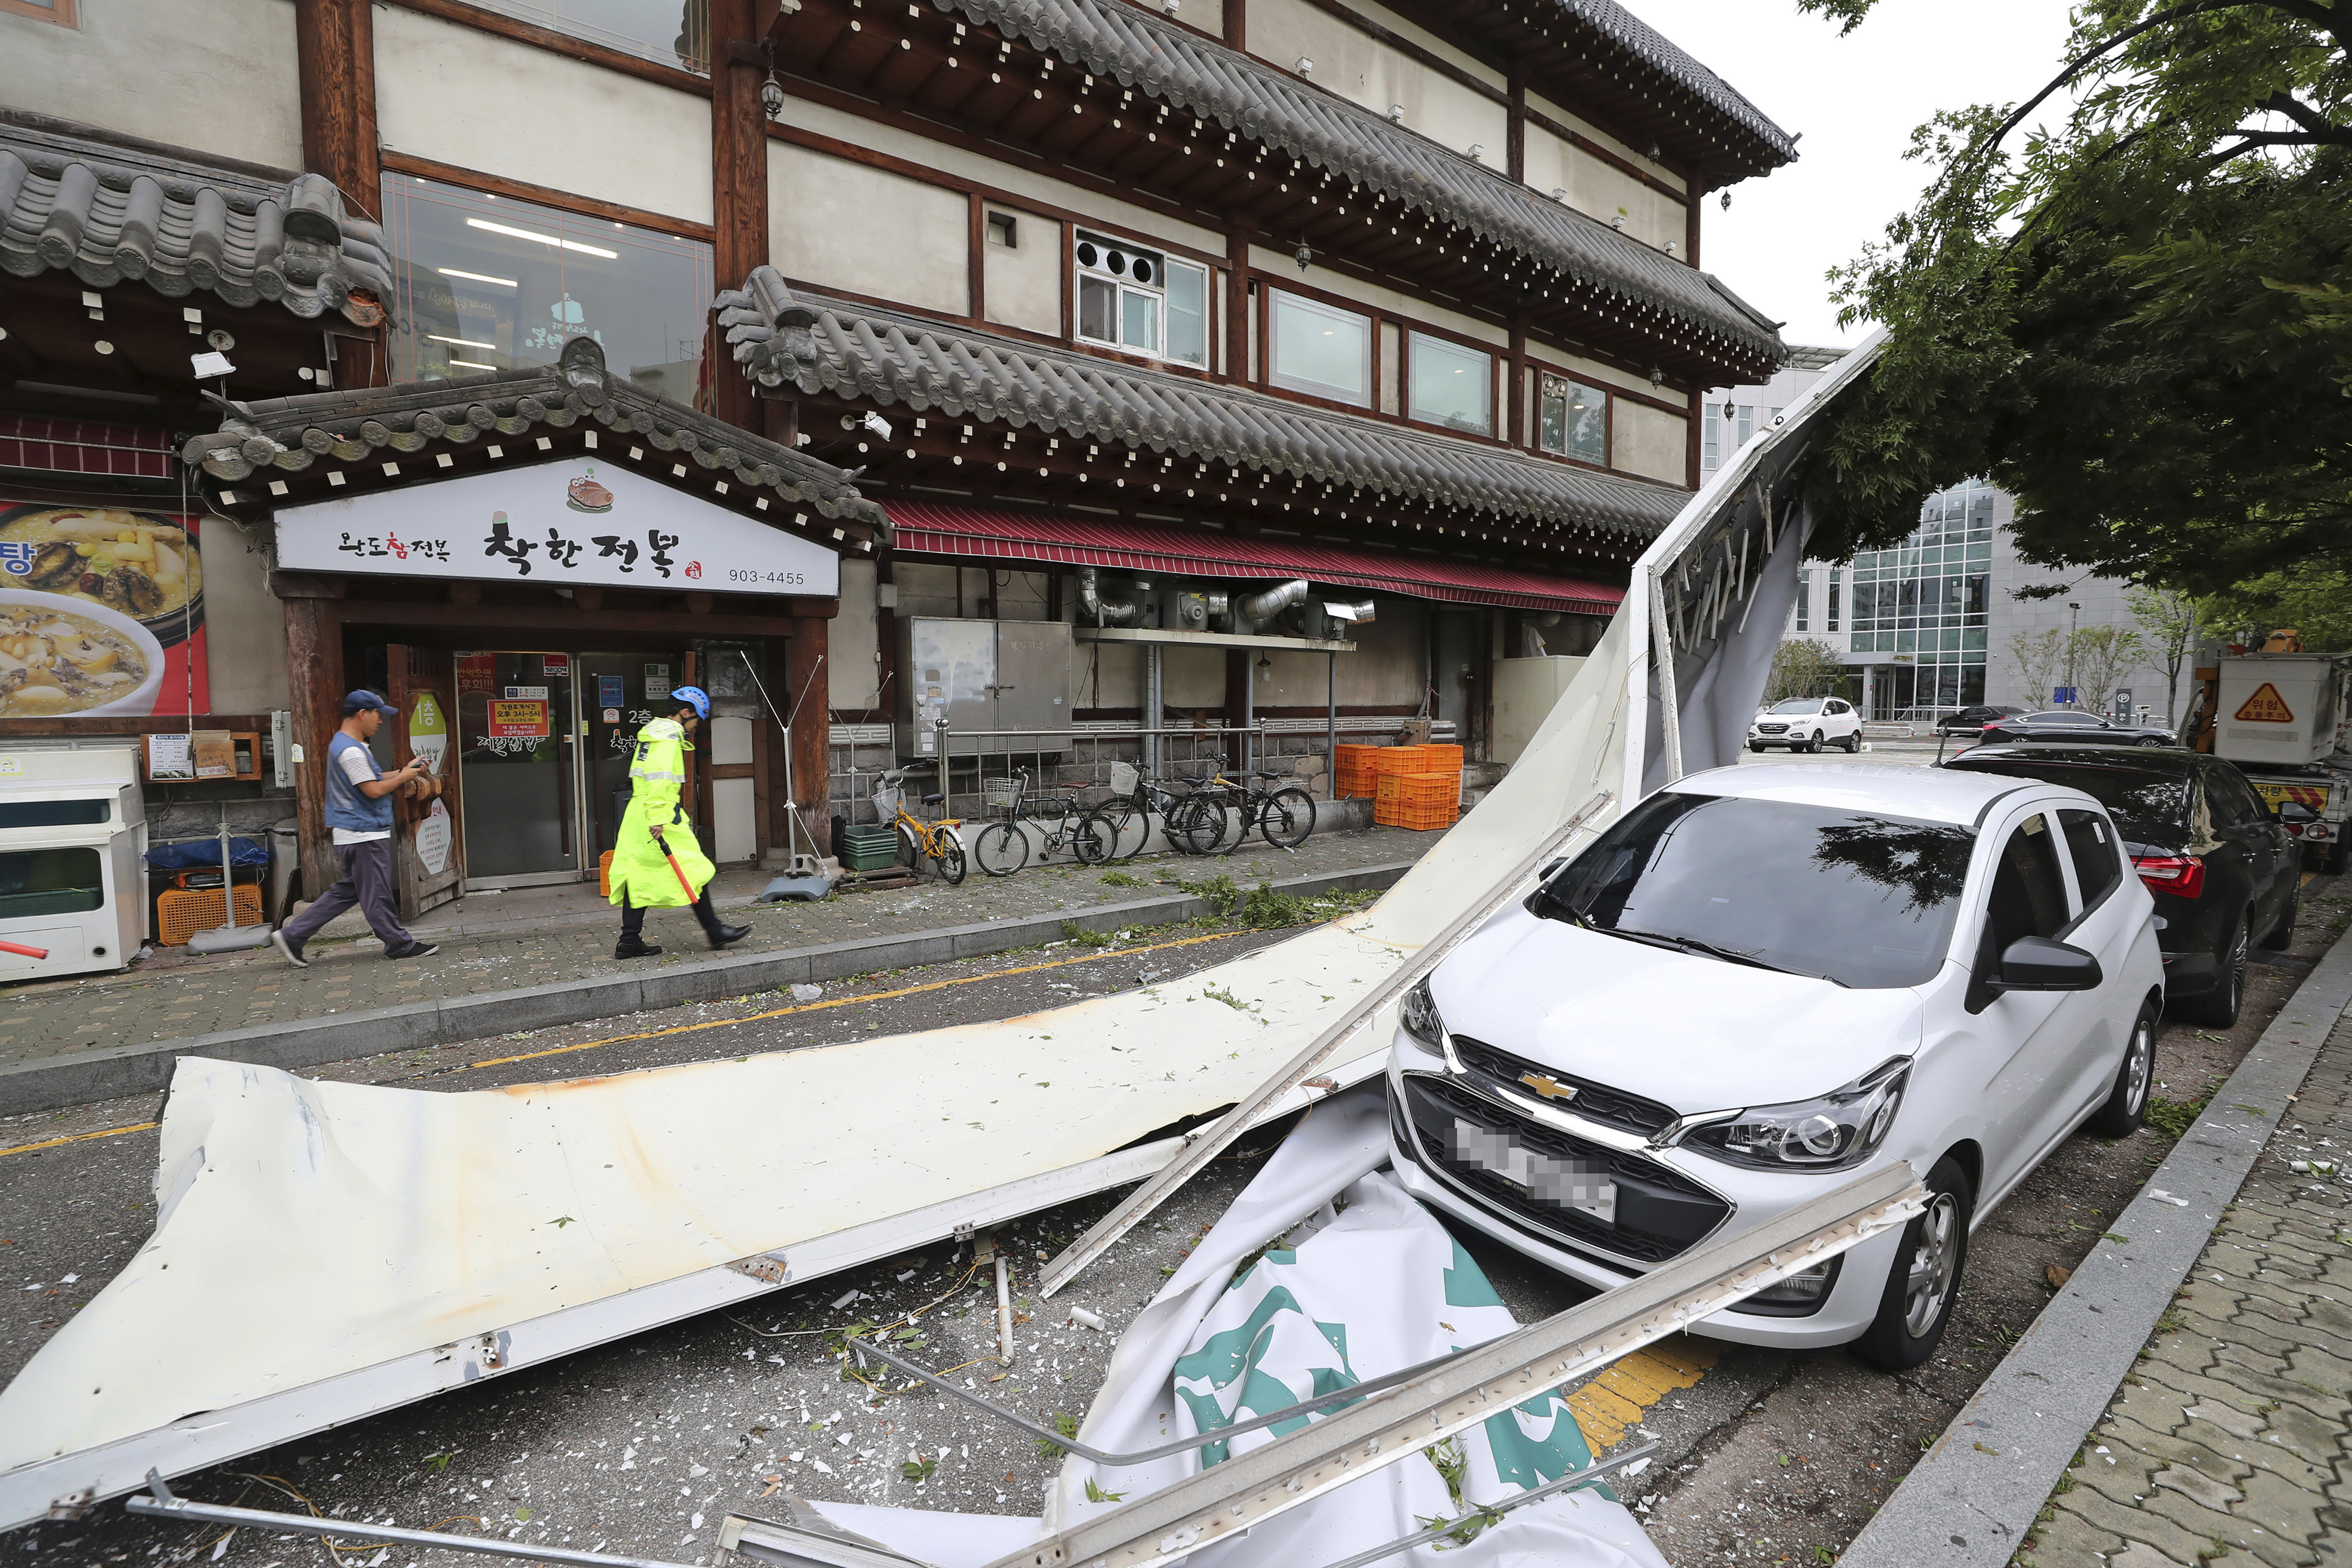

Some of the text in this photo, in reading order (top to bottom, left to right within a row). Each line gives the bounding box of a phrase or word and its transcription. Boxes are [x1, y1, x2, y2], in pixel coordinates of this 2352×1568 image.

[0, 541, 38, 576] 탕
[729, 569, 804, 585] 903-4455
[2252, 700, 2278, 710] 위험
[416, 700, 435, 727] 1층
[628, 709, 652, 724] 2층
[2258, 785, 2282, 796] 차량
